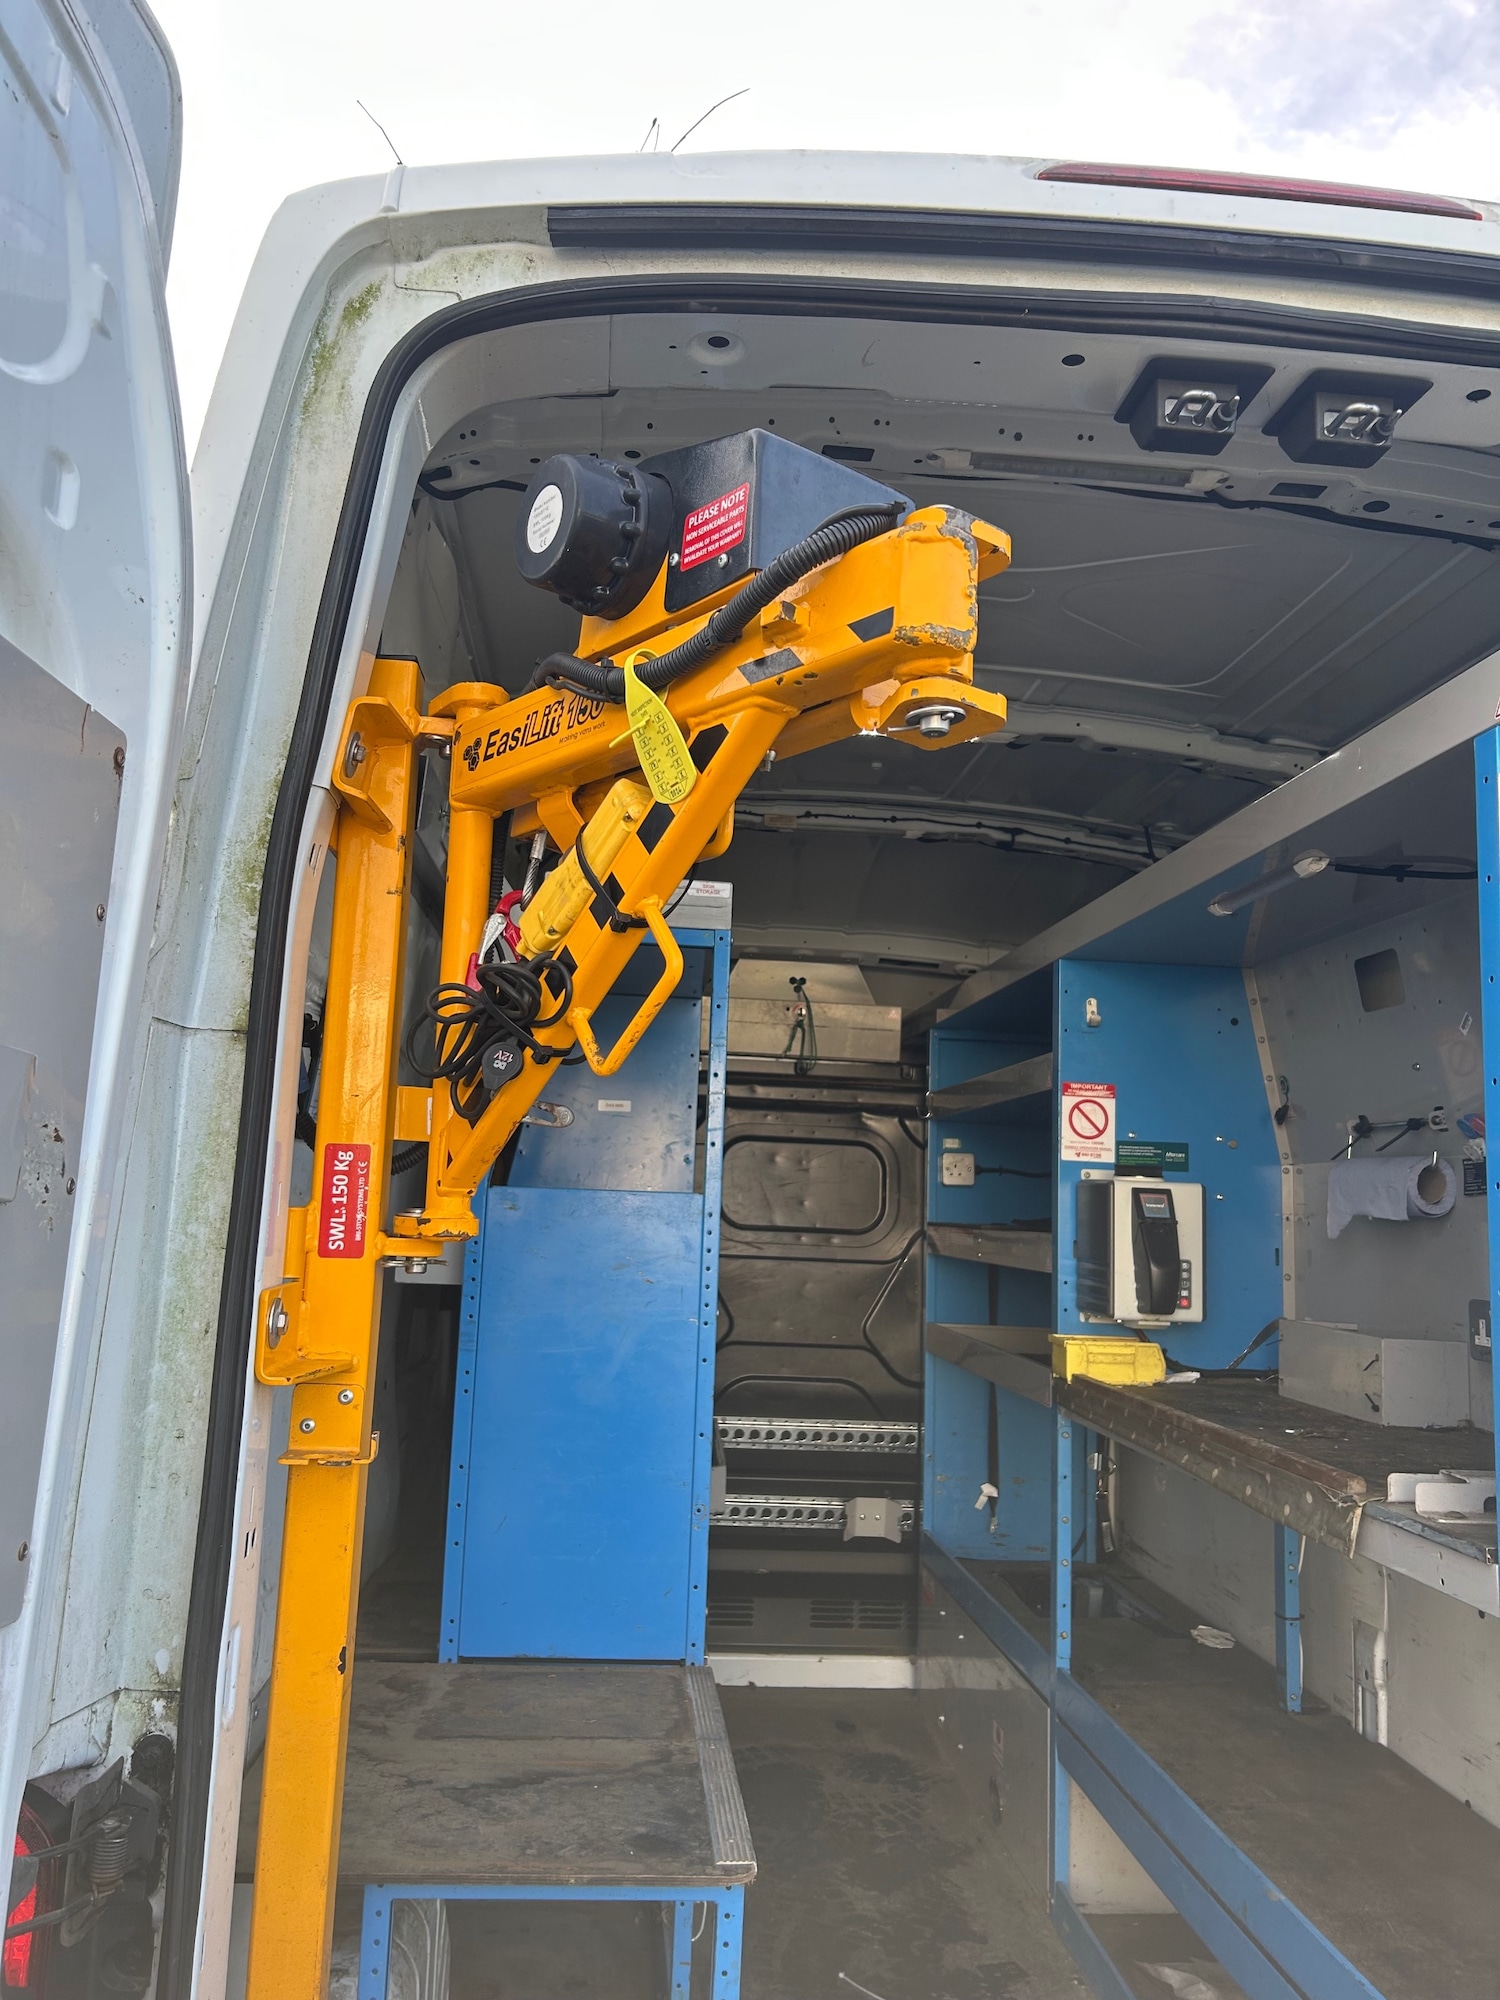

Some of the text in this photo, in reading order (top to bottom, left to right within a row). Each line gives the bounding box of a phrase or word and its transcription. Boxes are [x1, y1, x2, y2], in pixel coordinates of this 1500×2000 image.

[685, 504, 745, 542] NON SERVICEABLE PARTS
[688, 488, 746, 529] PLEASE NOTE
[684, 543, 704, 556] REMOVAL
[720, 525, 734, 538] COVER
[707, 541, 720, 553] YOUR
[720, 529, 743, 547] WARRANTY
[483, 694, 605, 762] EasiLift 150
[333, 1150, 354, 1171] Kg
[332, 1174, 349, 1204] 150
[358, 1177, 366, 1188] LTD
